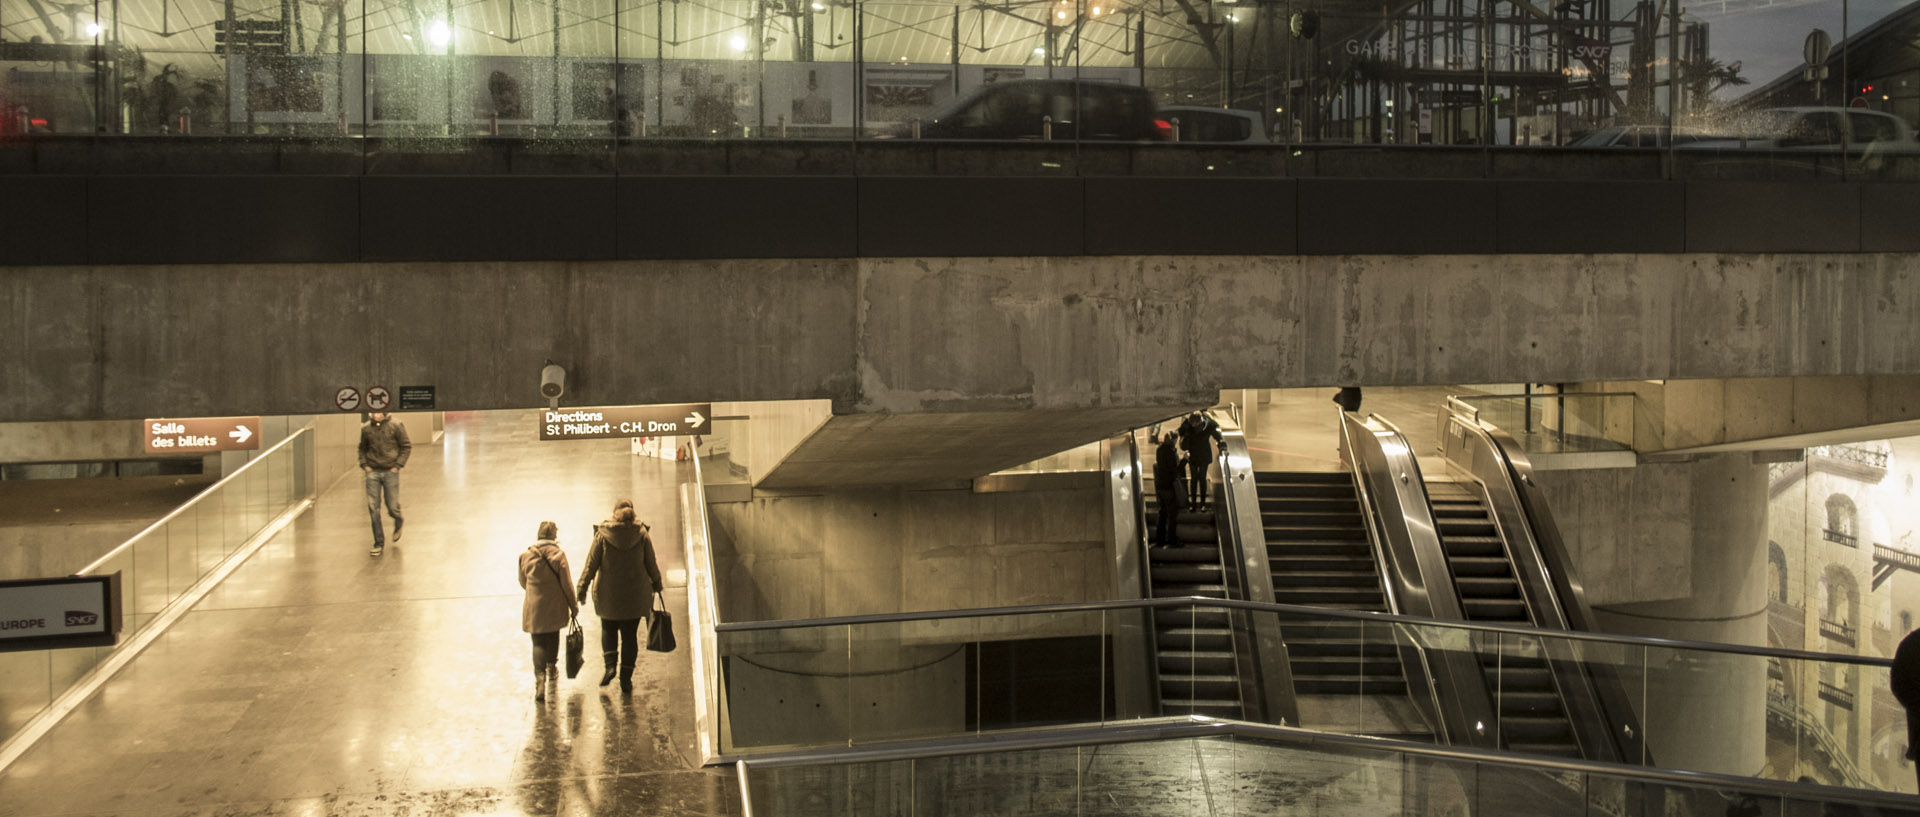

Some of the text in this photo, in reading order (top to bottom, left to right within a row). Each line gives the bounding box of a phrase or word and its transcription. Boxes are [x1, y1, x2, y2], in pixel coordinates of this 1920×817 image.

[1574, 45, 1609, 59] SNCF
[546, 411, 603, 423] Directions
[152, 423, 185, 434] Salle
[546, 424, 560, 435] St
[564, 422, 610, 435] Philibert
[620, 422, 644, 433] C.H.
[648, 421, 676, 432] Dron
[152, 435, 217, 448] des billets
[0, 618, 45, 631] UROPE
[66, 615, 98, 626] SNCF
